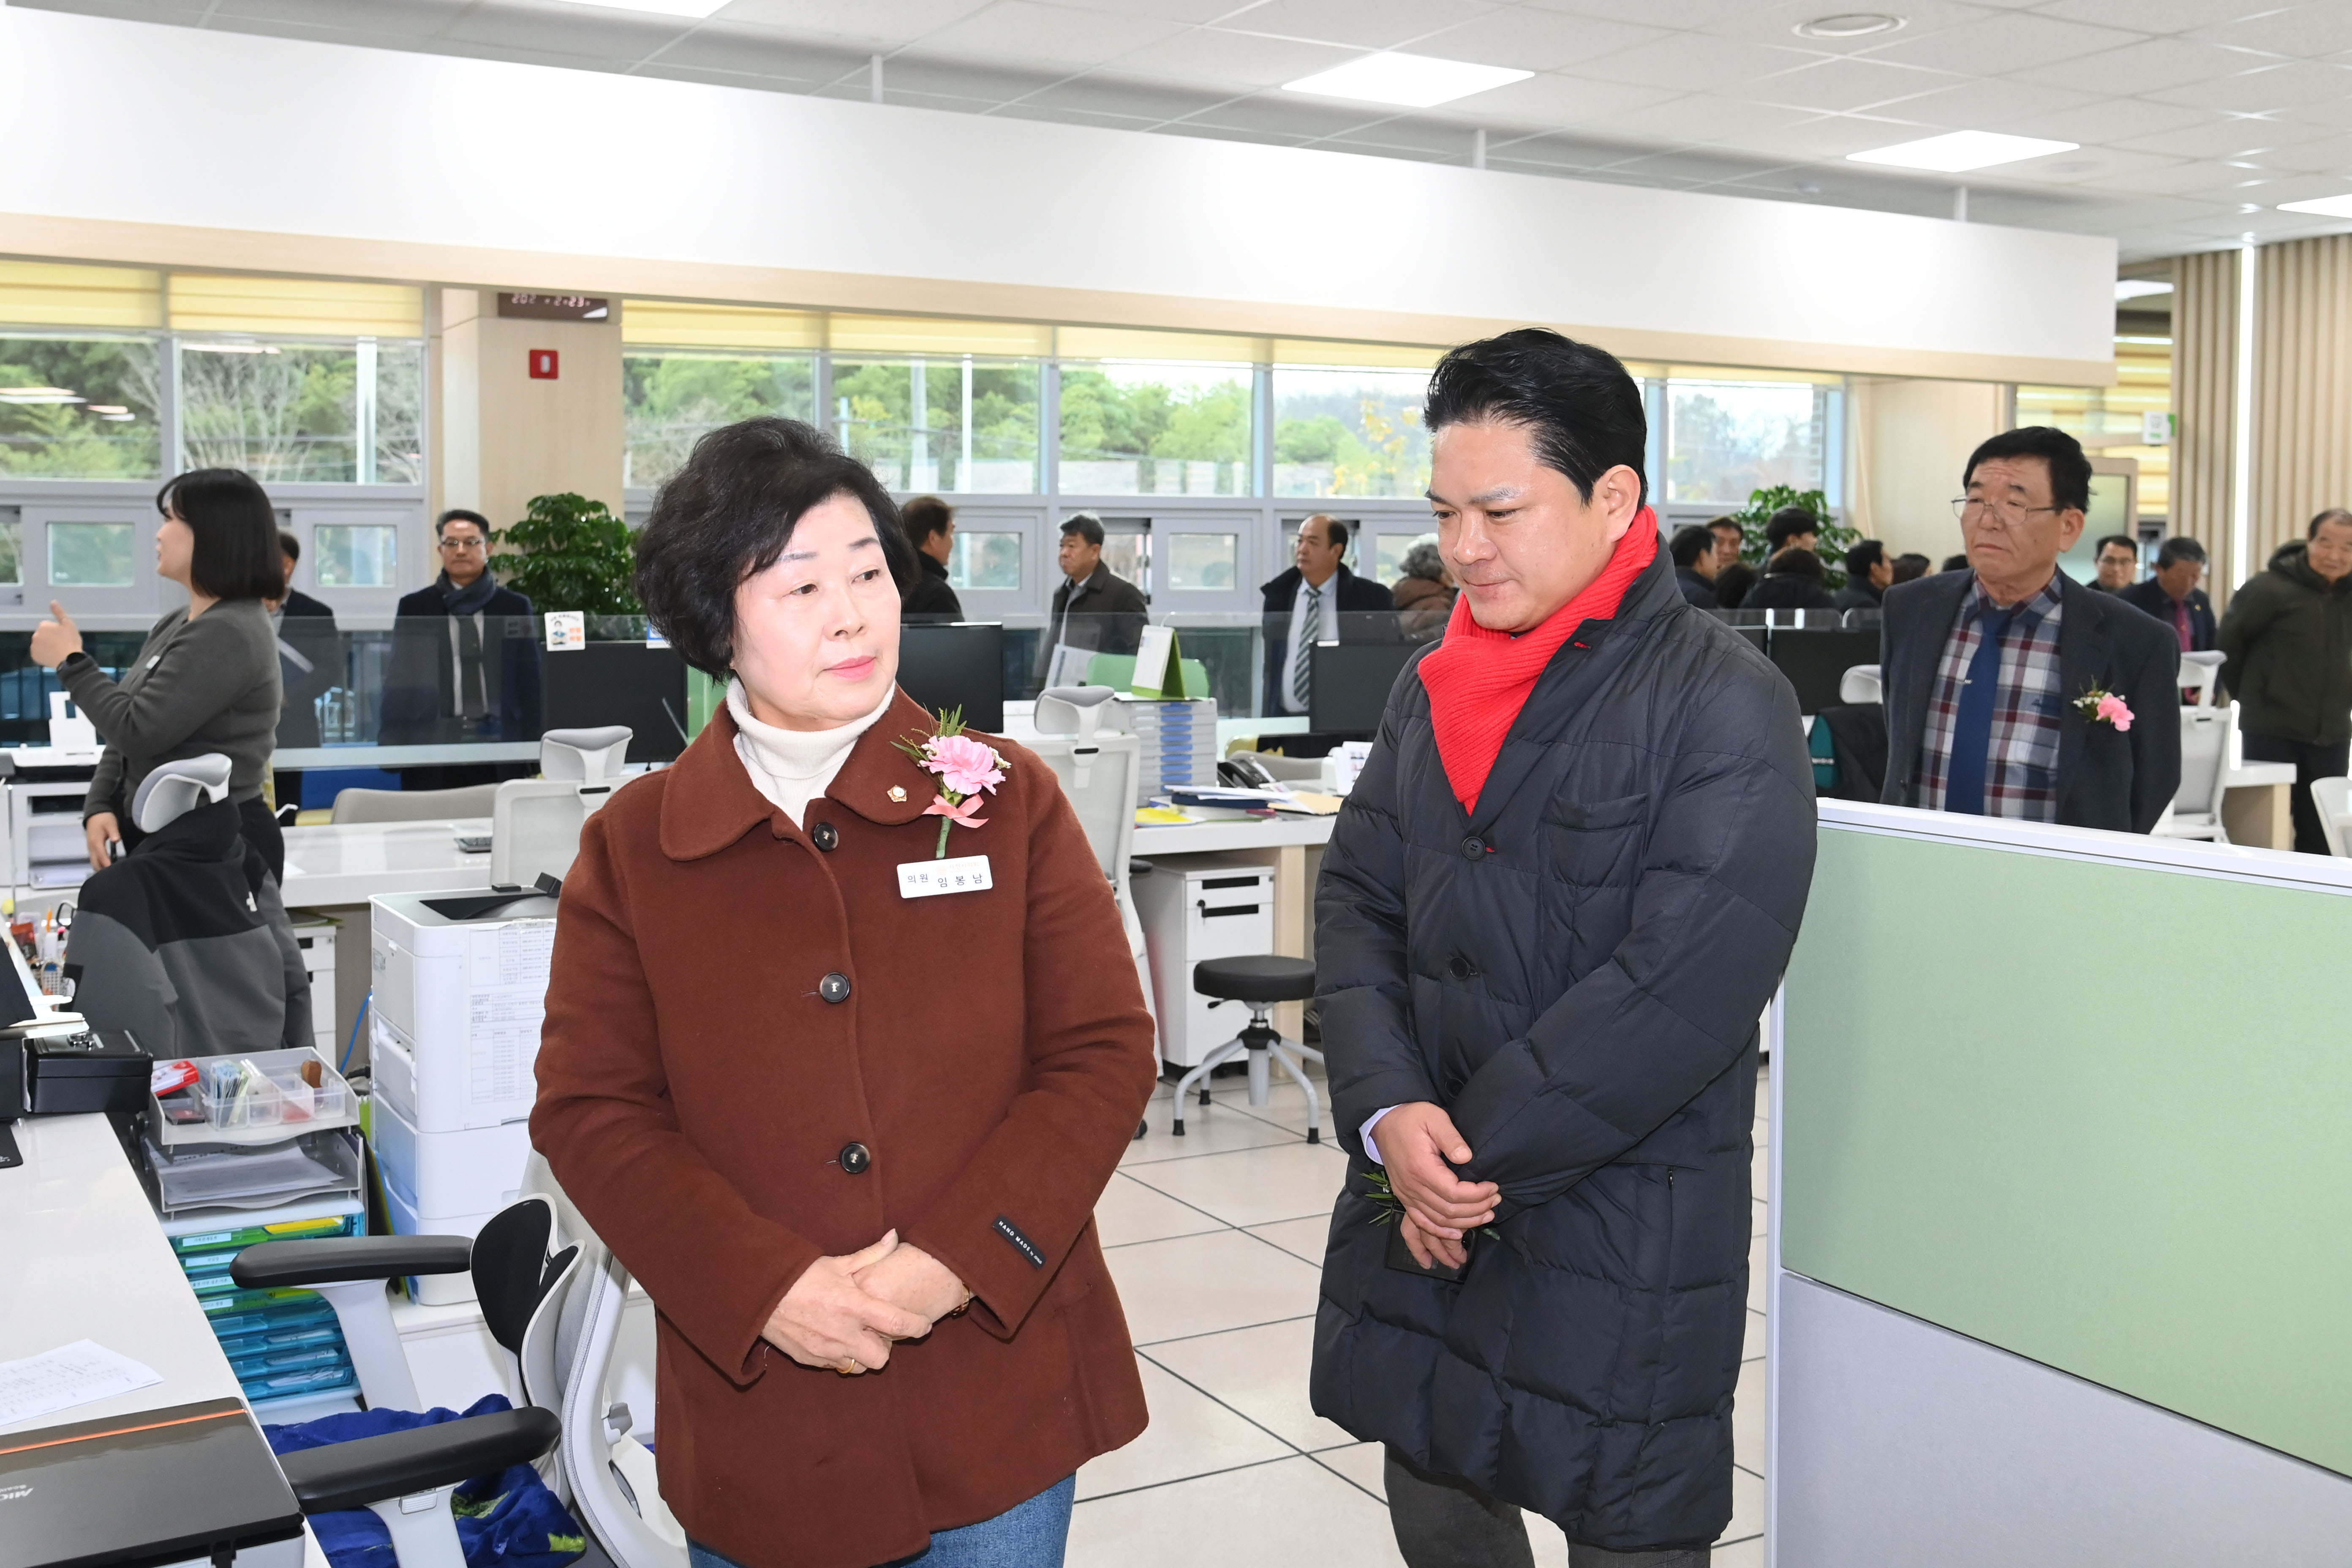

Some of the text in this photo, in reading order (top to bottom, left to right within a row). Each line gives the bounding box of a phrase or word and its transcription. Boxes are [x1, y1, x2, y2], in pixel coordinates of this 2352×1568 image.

[908, 874, 928, 883] 의원
[999, 1221, 1014, 1236] HAND
[1015, 1236, 1031, 1251] MADE
